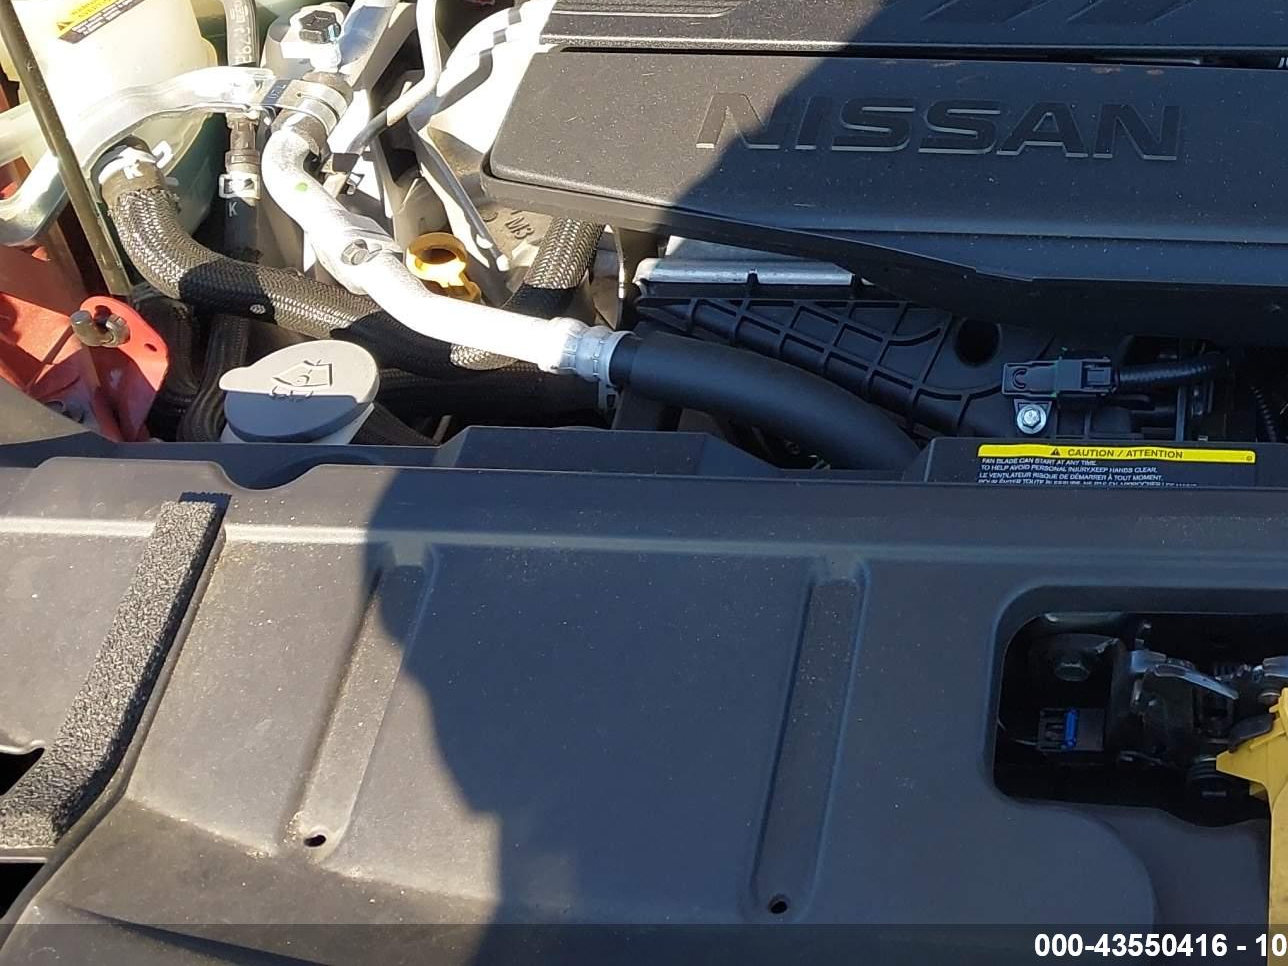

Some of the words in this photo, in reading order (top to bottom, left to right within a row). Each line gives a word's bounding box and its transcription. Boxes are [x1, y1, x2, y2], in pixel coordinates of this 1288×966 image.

[695, 91, 1181, 161] NISSAN
[1068, 448, 1115, 457] CAUTION
[1125, 449, 1184, 459] ATTENTION
[989, 471, 1031, 479] VENTILATEUR
